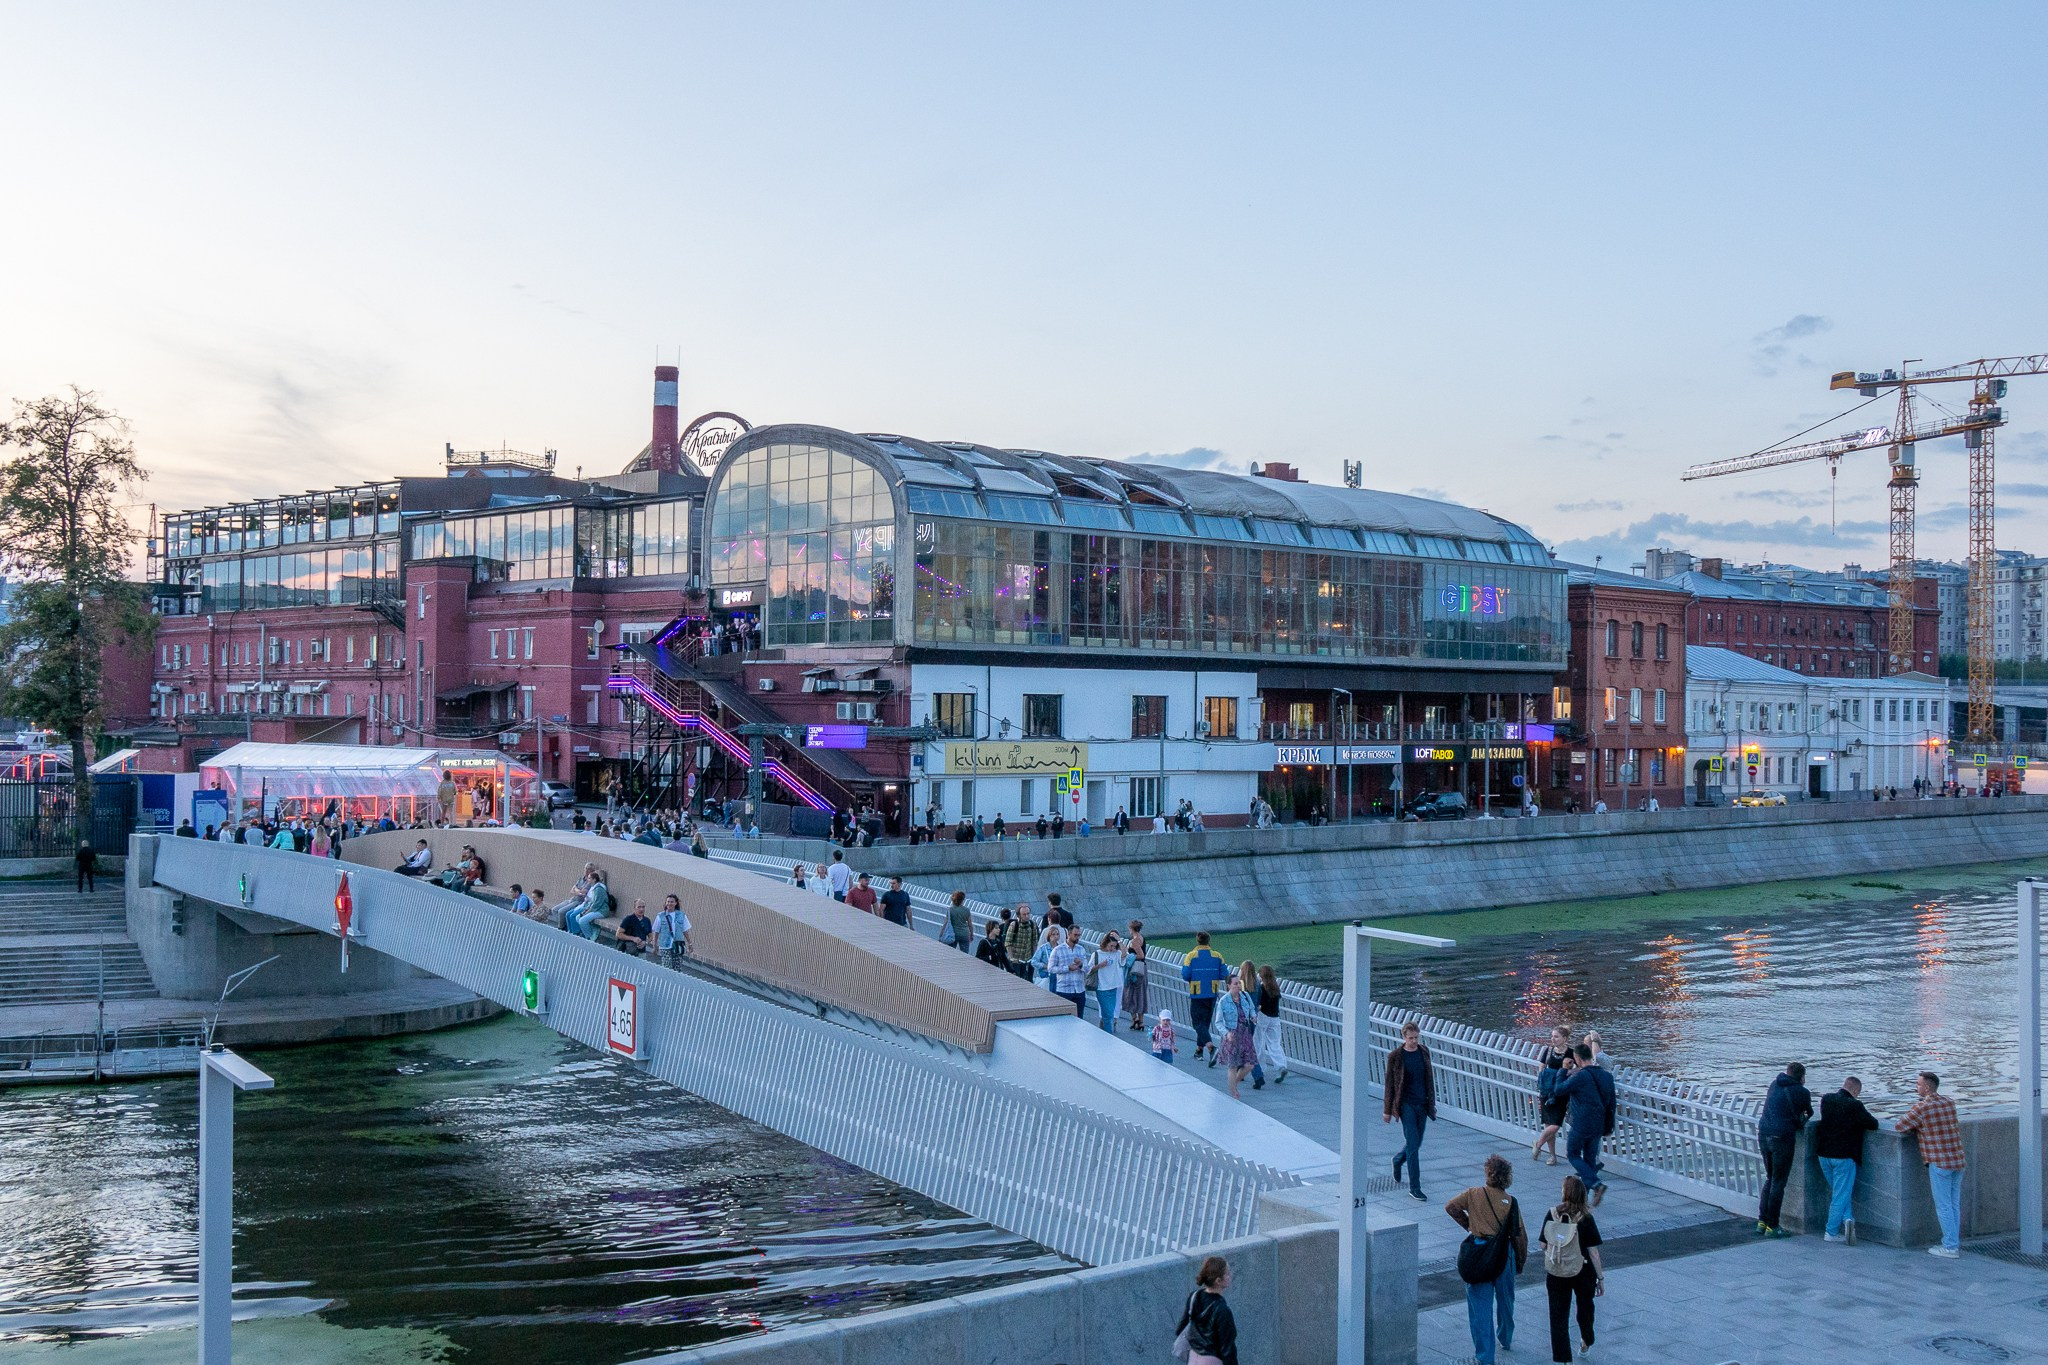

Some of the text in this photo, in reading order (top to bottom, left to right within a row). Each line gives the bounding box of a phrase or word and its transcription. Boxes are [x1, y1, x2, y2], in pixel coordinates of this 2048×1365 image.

[1441, 584, 1510, 614] GIPSY
[1278, 748, 1321, 763] КРЫМ
[611, 1006, 632, 1037] 4.65
[1353, 1197, 1366, 1209] 23
